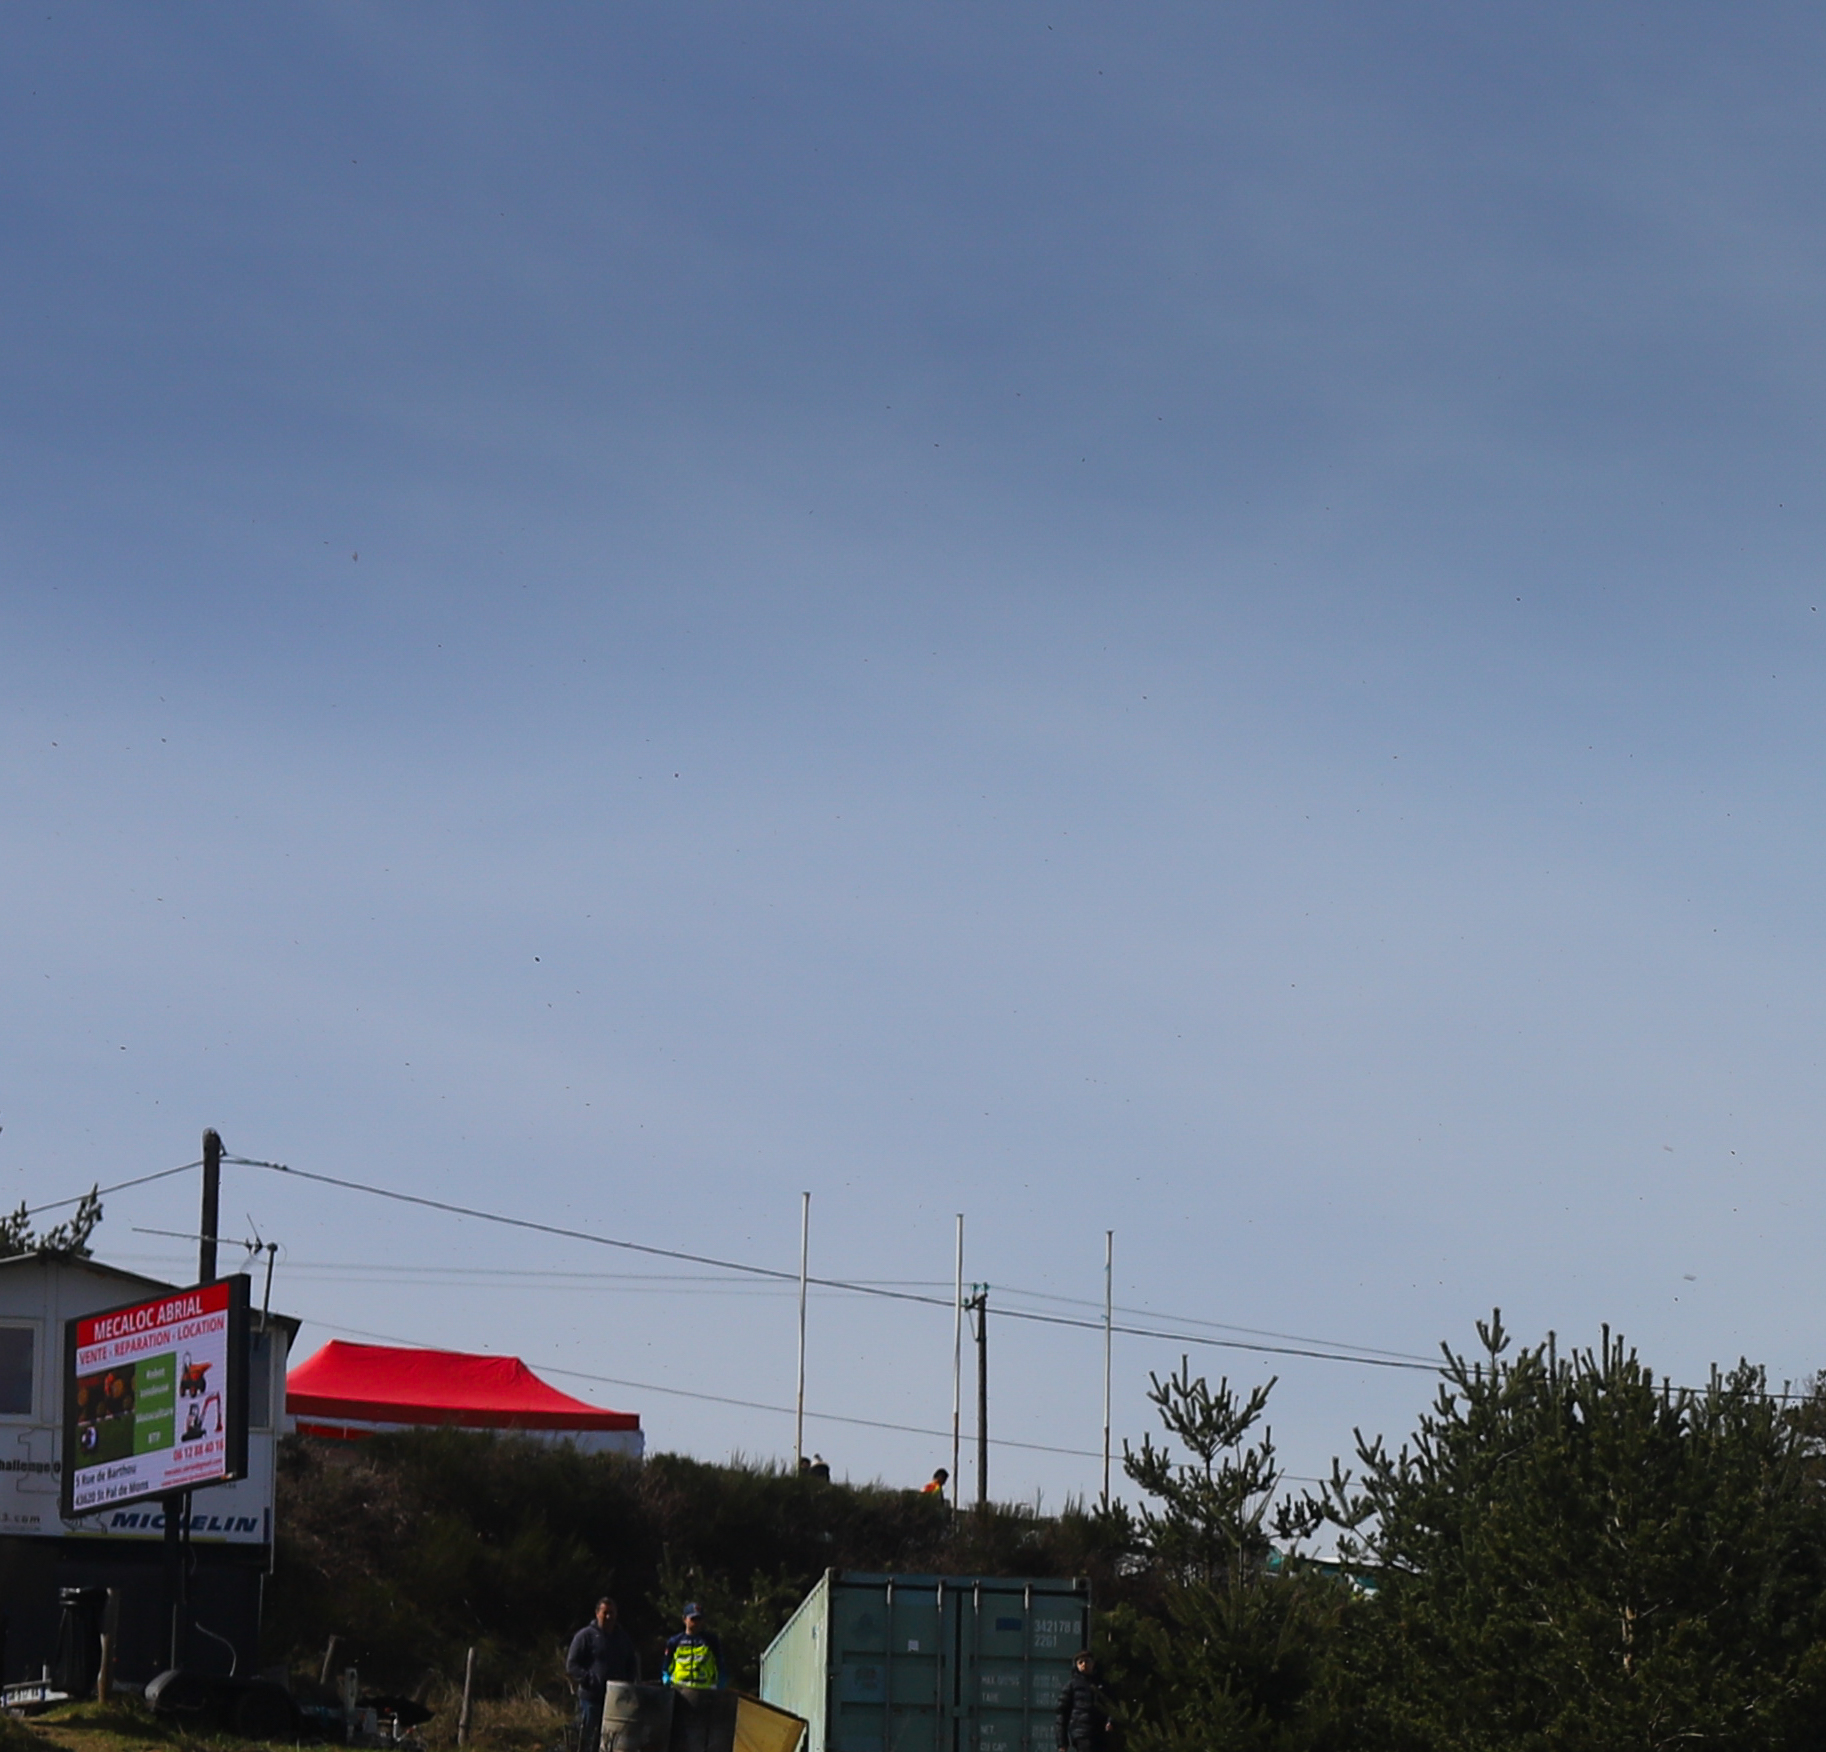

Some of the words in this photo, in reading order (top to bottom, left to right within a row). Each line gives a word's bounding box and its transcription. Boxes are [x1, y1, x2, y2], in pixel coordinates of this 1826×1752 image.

[94, 1307, 155, 1342] MECALOC
[156, 1295, 203, 1325] ABRIAL
[79, 1346, 107, 1365] VENTE
[113, 1330, 171, 1357] REPARATION
[177, 1316, 224, 1341] LOCATION
[82, 1473, 95, 1485] Rue
[96, 1469, 106, 1482] de
[118, 1484, 127, 1496] de
[111, 1513, 258, 1533] MICELIN
